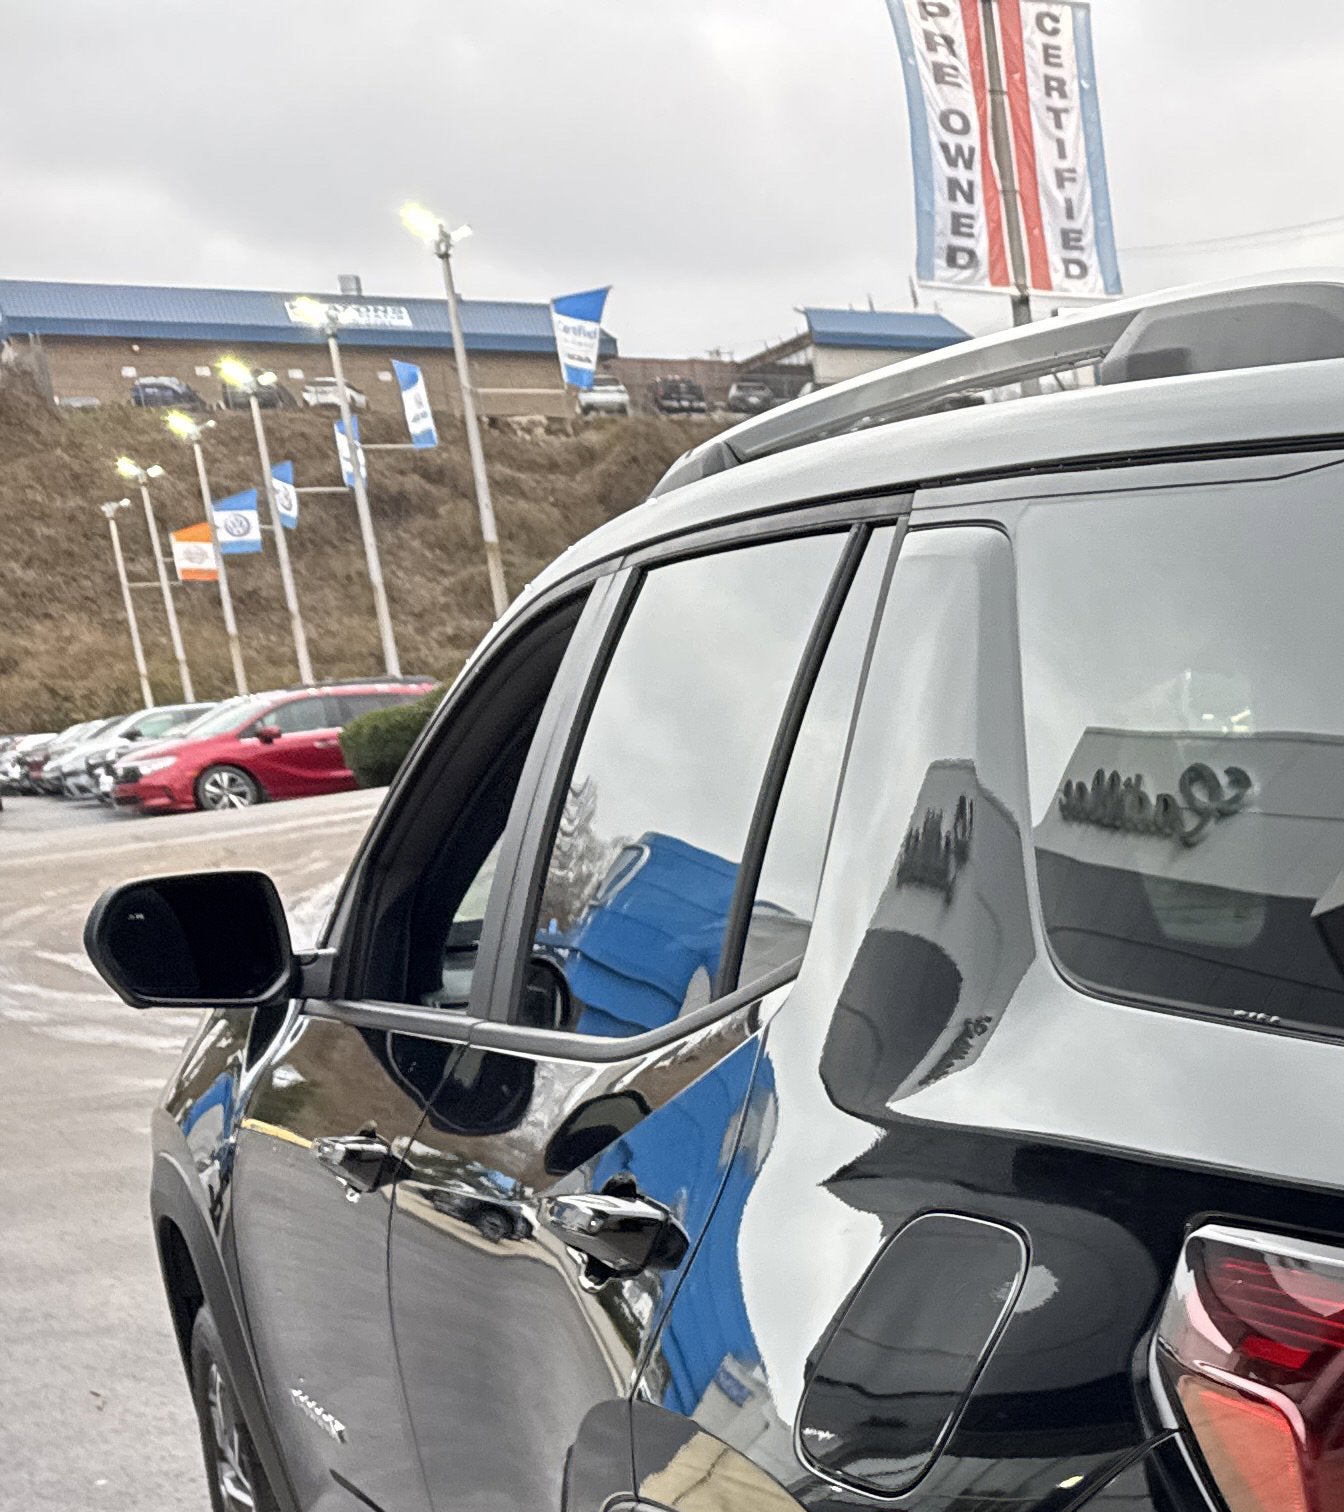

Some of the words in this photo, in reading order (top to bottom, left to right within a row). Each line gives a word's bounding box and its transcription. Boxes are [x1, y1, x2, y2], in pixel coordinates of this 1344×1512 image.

[919, 0, 963, 88] PRE
[938, 108, 980, 271] OWNED
[1035, 10, 1089, 281] CERTIFIED
